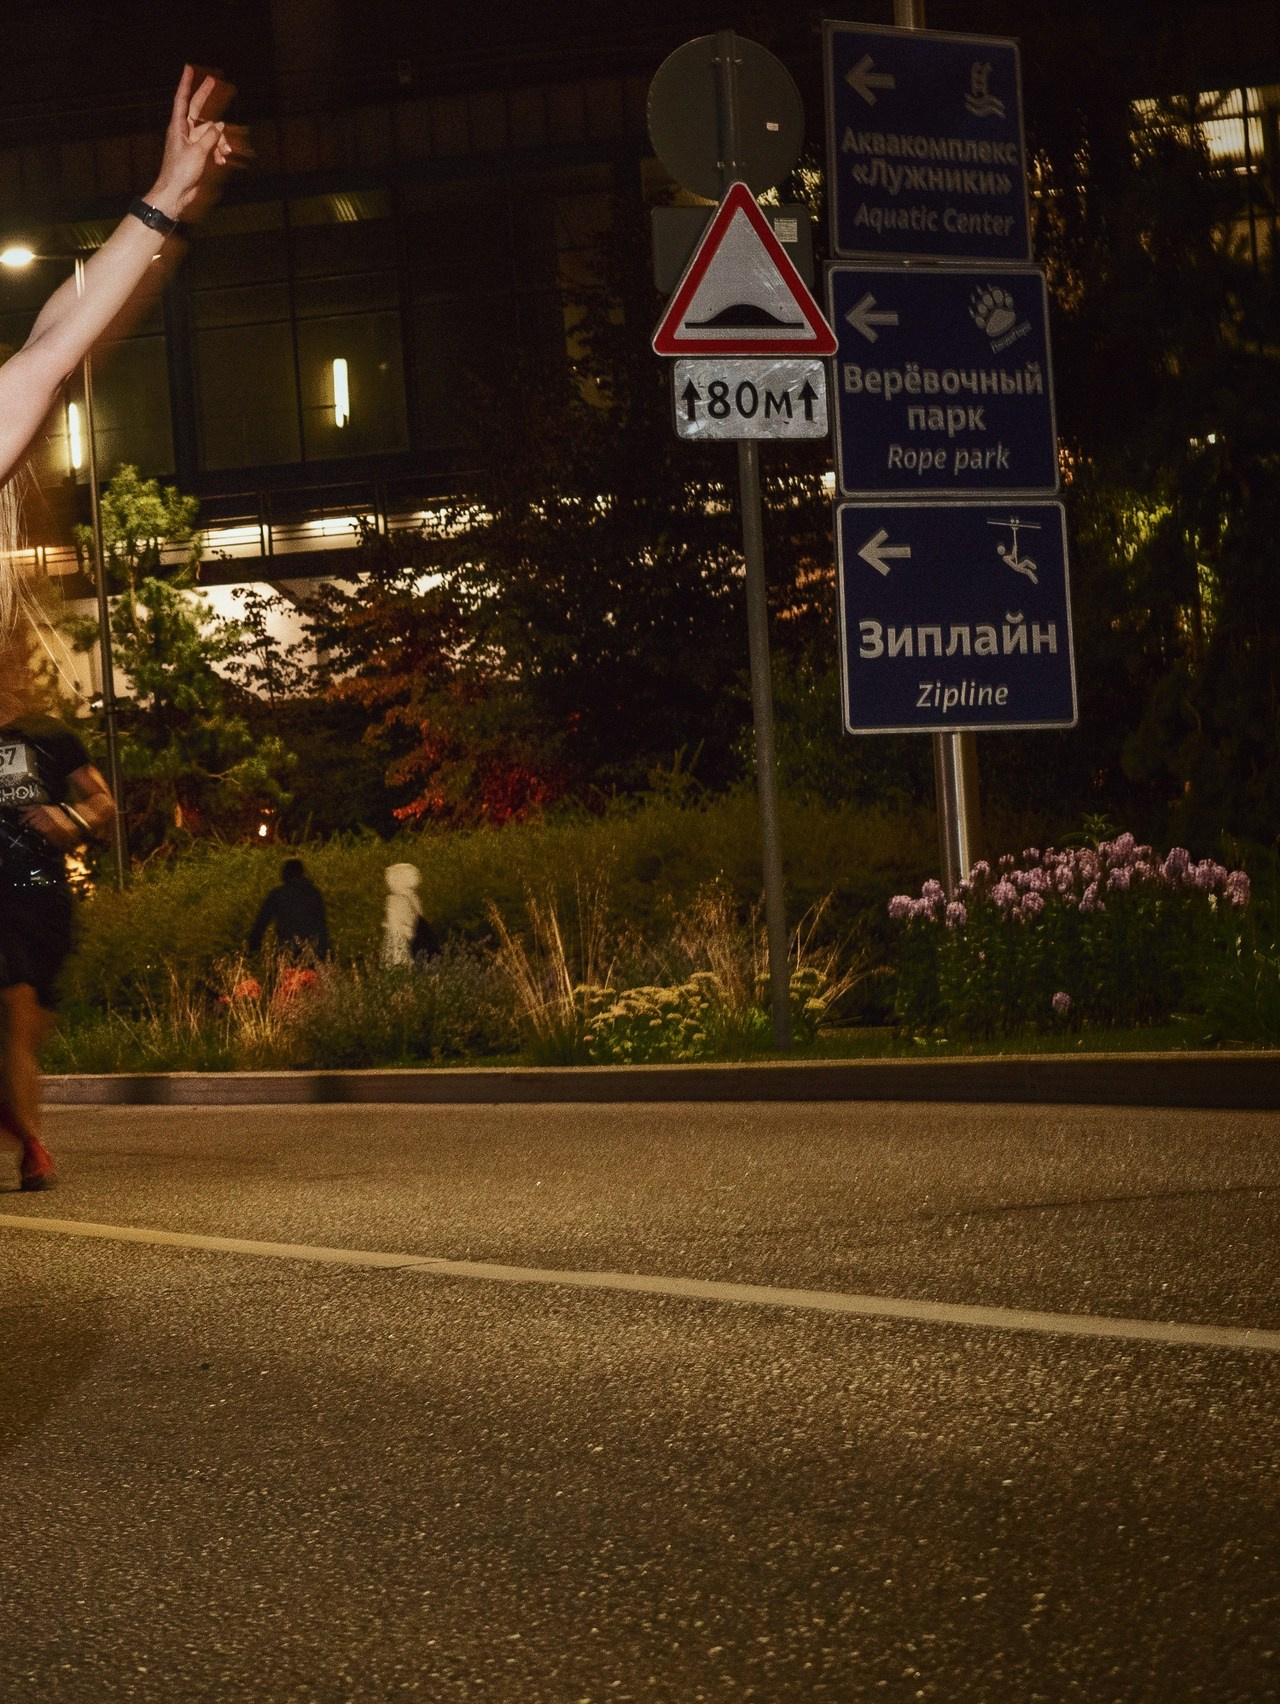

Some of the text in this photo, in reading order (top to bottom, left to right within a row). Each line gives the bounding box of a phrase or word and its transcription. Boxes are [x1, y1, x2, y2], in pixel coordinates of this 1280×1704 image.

[841, 127, 1019, 165] Аквакомплекс
[851, 158, 1012, 196] «Лужники»
[854, 202, 1016, 237] Aquatic Center
[843, 362, 1045, 400] Верёвочный
[907, 404, 987, 437] парк
[887, 443, 1010, 475] Rope park
[858, 611, 1058, 660] Зиплайн
[916, 681, 1009, 714] Zipline
